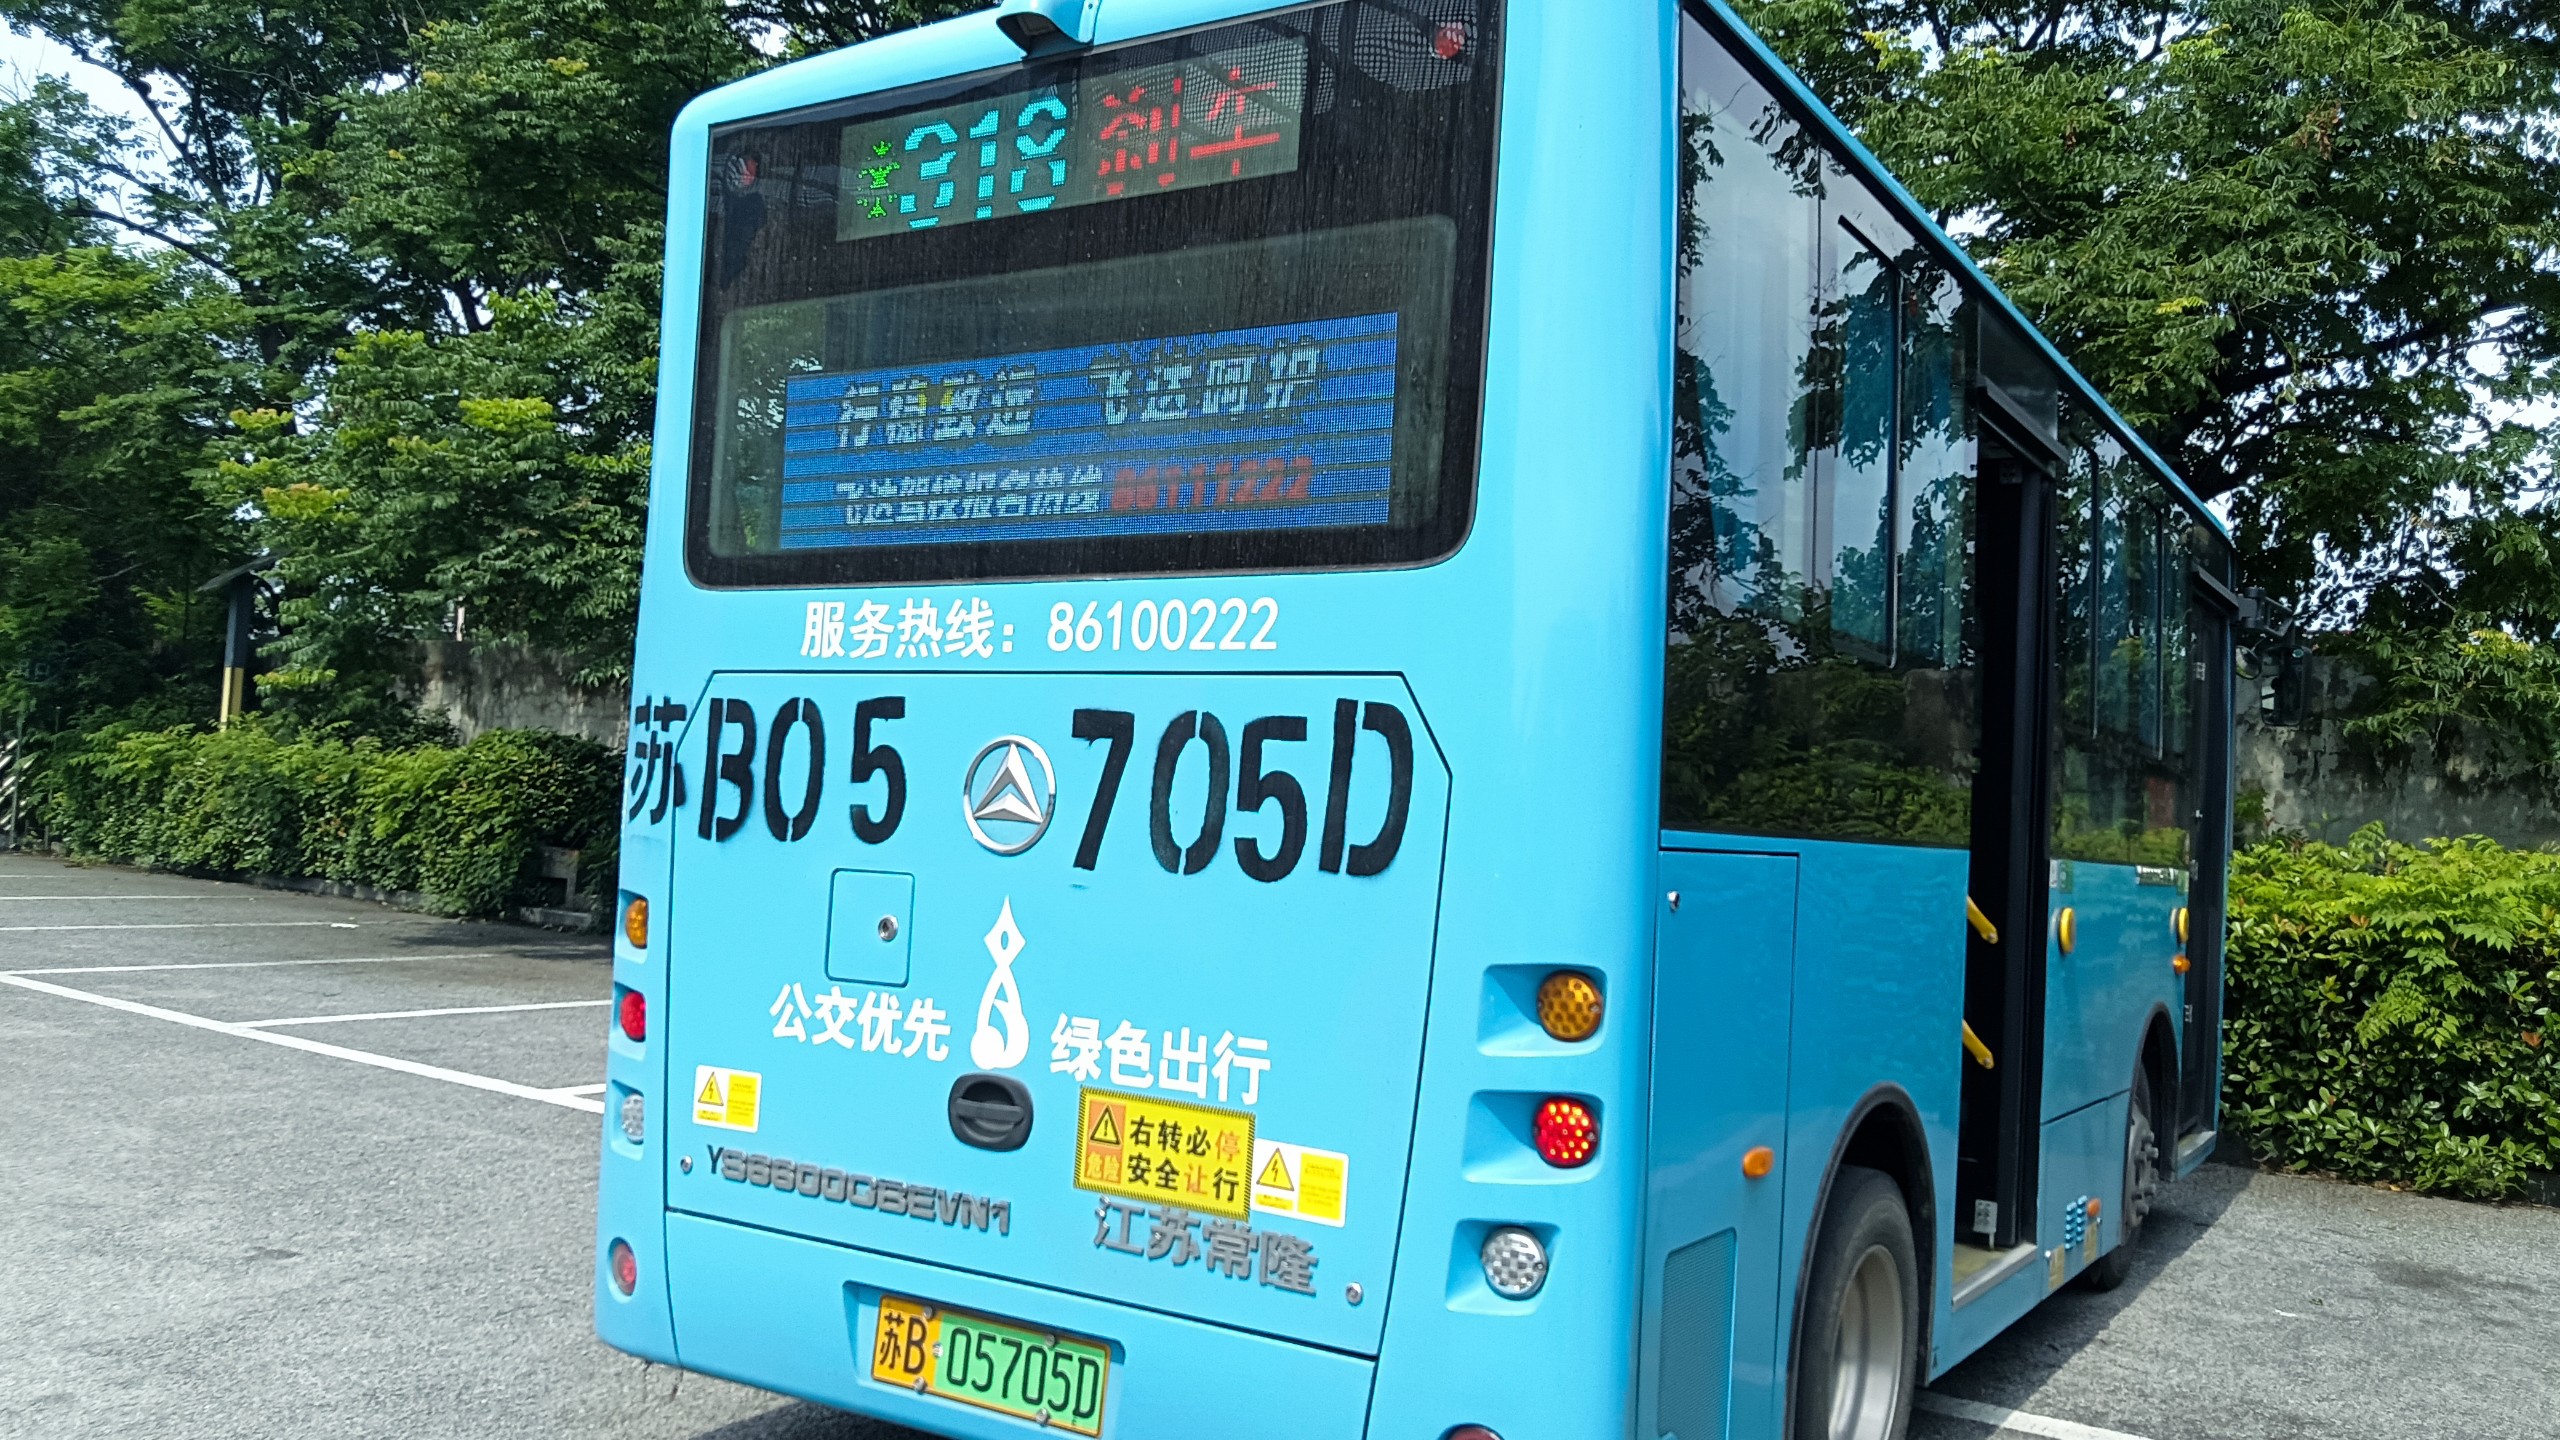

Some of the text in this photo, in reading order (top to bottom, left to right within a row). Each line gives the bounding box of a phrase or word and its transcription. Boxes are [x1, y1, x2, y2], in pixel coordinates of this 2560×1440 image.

[900, 96, 1068, 229] 318
[769, 982, 1271, 1105] 公交优先 绿色出行
[1086, 1150, 1123, 1185] 危险
[1129, 1115, 1241, 1162] 右转必停
[1127, 1153, 1240, 1202] 安全让行
[1093, 1196, 1320, 1297] 江苏常隆
